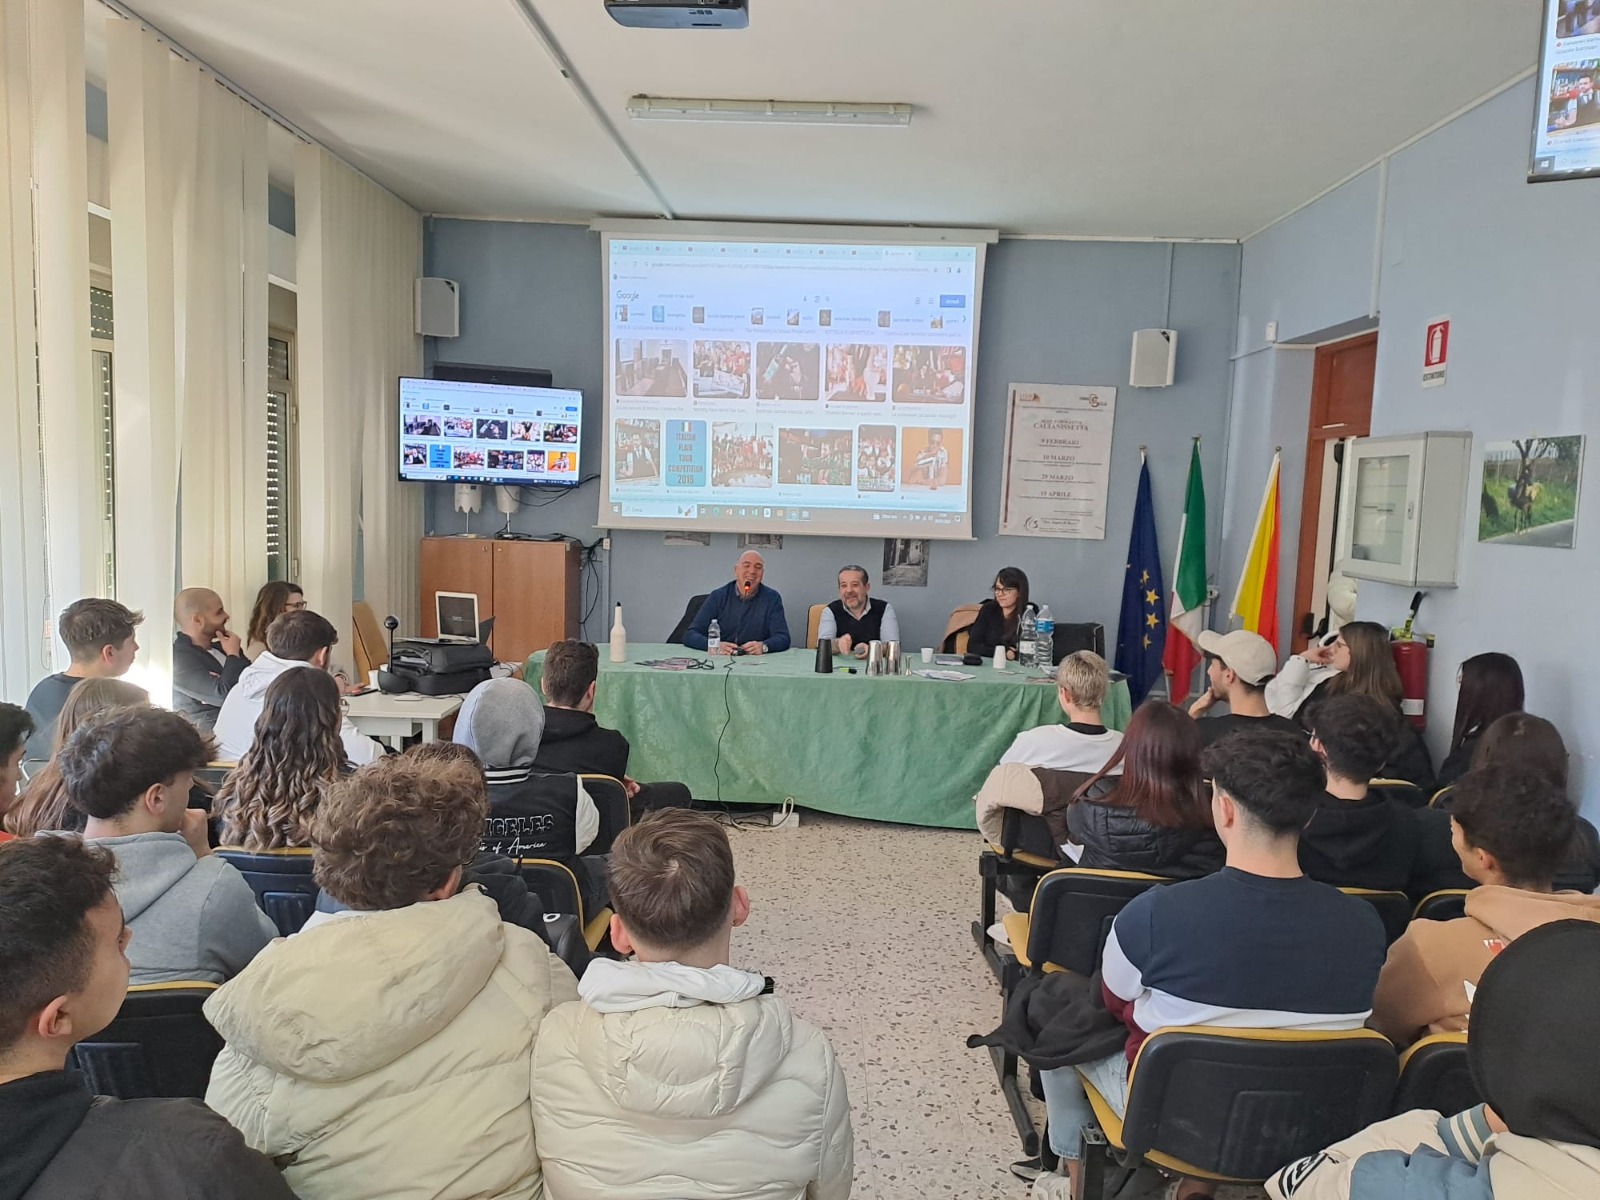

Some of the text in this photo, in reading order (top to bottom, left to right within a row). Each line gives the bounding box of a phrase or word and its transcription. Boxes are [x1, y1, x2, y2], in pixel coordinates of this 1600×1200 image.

[616, 290, 639, 301] Google
[1049, 474, 1074, 482] MARZO
[492, 841, 503, 855] of
[507, 836, 546, 855] America
